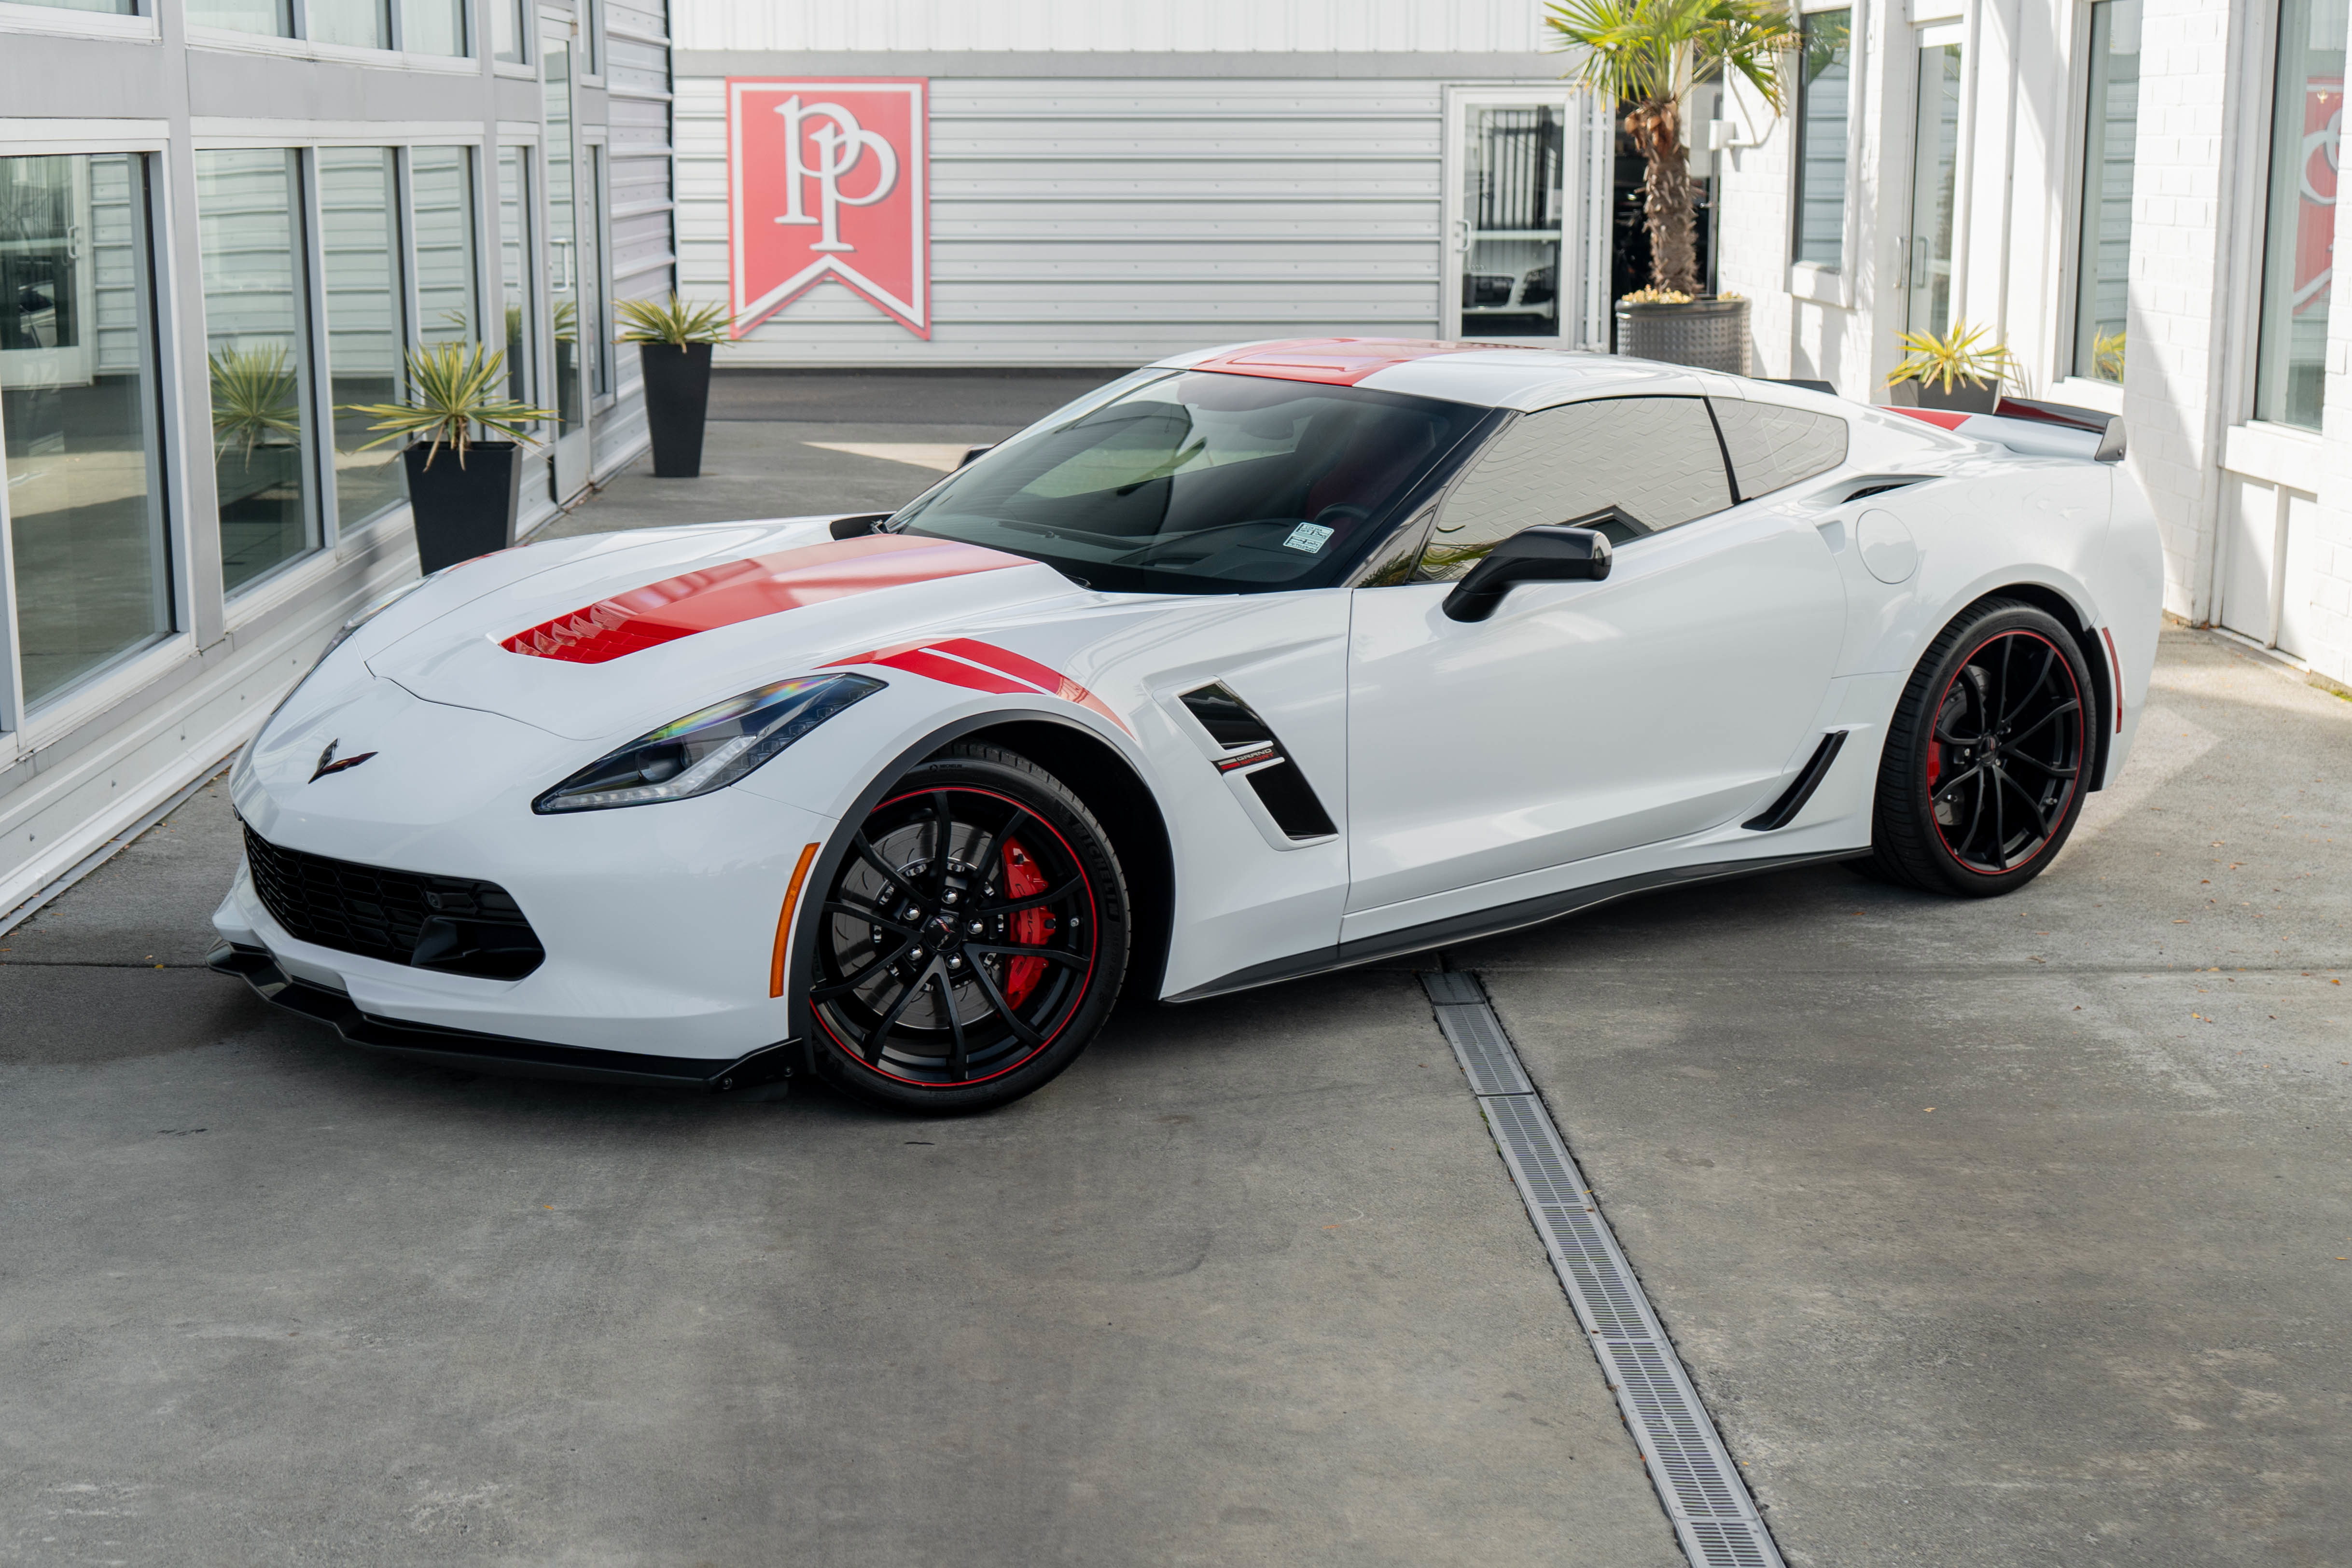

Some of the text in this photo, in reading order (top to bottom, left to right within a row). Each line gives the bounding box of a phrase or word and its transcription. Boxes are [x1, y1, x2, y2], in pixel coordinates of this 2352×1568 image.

[1237, 749, 1272, 761] GRAND
[1239, 752, 1274, 764] SPORT
[1072, 822, 1119, 916] MICHELIN
